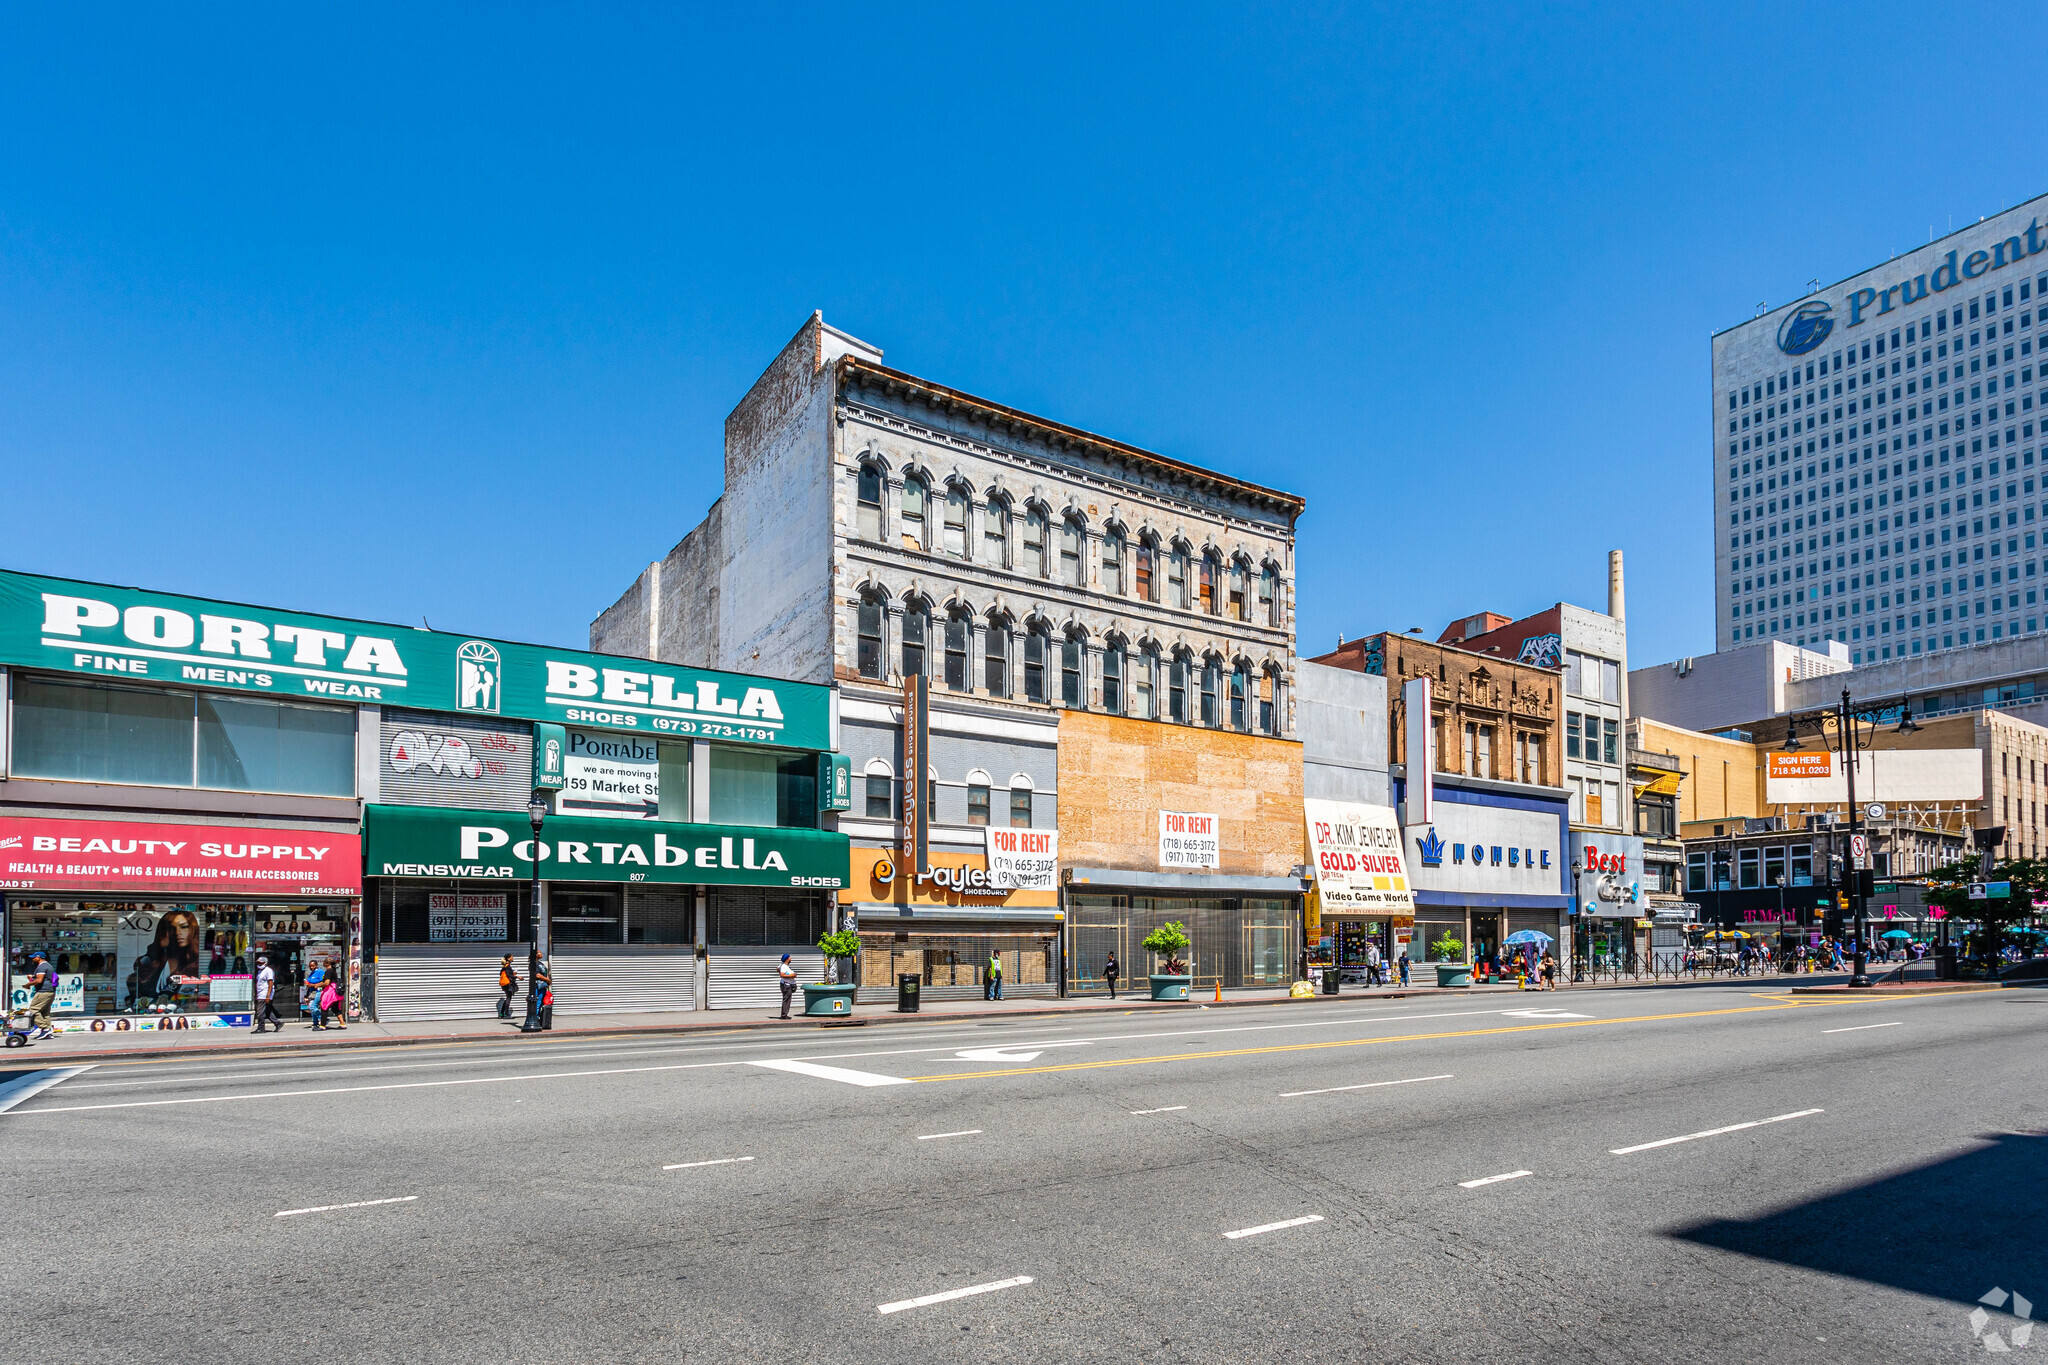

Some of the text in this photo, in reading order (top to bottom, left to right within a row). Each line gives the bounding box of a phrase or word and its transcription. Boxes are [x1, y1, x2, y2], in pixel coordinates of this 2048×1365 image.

[1847, 217, 2048, 328] Prudent
[41, 593, 407, 675] PORTA
[74, 653, 382, 699] FINE MEN'S WEAR
[546, 661, 784, 721] BELLA
[566, 709, 775, 740] SHOES (973) 273-1791
[1778, 756, 1821, 765] SIGN HERE
[617, 769, 651, 780] moving
[1772, 766, 1829, 775] 718.941.0203
[540, 775, 562, 785] WEAR
[564, 777, 587, 789] 159
[592, 780, 640, 794] Market
[833, 798, 850, 806] SHOES
[904, 757, 914, 839] Payless
[1166, 814, 1212, 834] FOR RENT
[994, 831, 1050, 853] FOR RENT
[1315, 822, 1398, 848] DR. KIM JEWELRY
[32, 836, 187, 855] BEAUTY
[200, 843, 330, 860] SUPPLY
[1163, 838, 1215, 851] (718) 665-3172
[1165, 851, 1214, 863] (917) 701-3171
[1320, 852, 1401, 873] GOLD SILVER
[1585, 846, 1627, 872] Best
[9, 862, 319, 881] HEALTH & BEAUTY WIG & HUMAN HAIR HAIR ACCESSORIES
[383, 863, 513, 877] MENSWEAR
[1015, 859, 1053, 871] 665-3172
[630, 873, 645, 882] 807
[791, 876, 841, 887] SHOES
[917, 864, 992, 892] Payles
[964, 888, 1008, 896] SHOESOURCE
[1325, 891, 1352, 901] Video
[1355, 892, 1381, 902] Game
[1384, 893, 1409, 902] World
[432, 896, 504, 908] STOR FOR RENT
[1883, 905, 1897, 919] T
[462, 917, 504, 925] 701-3171
